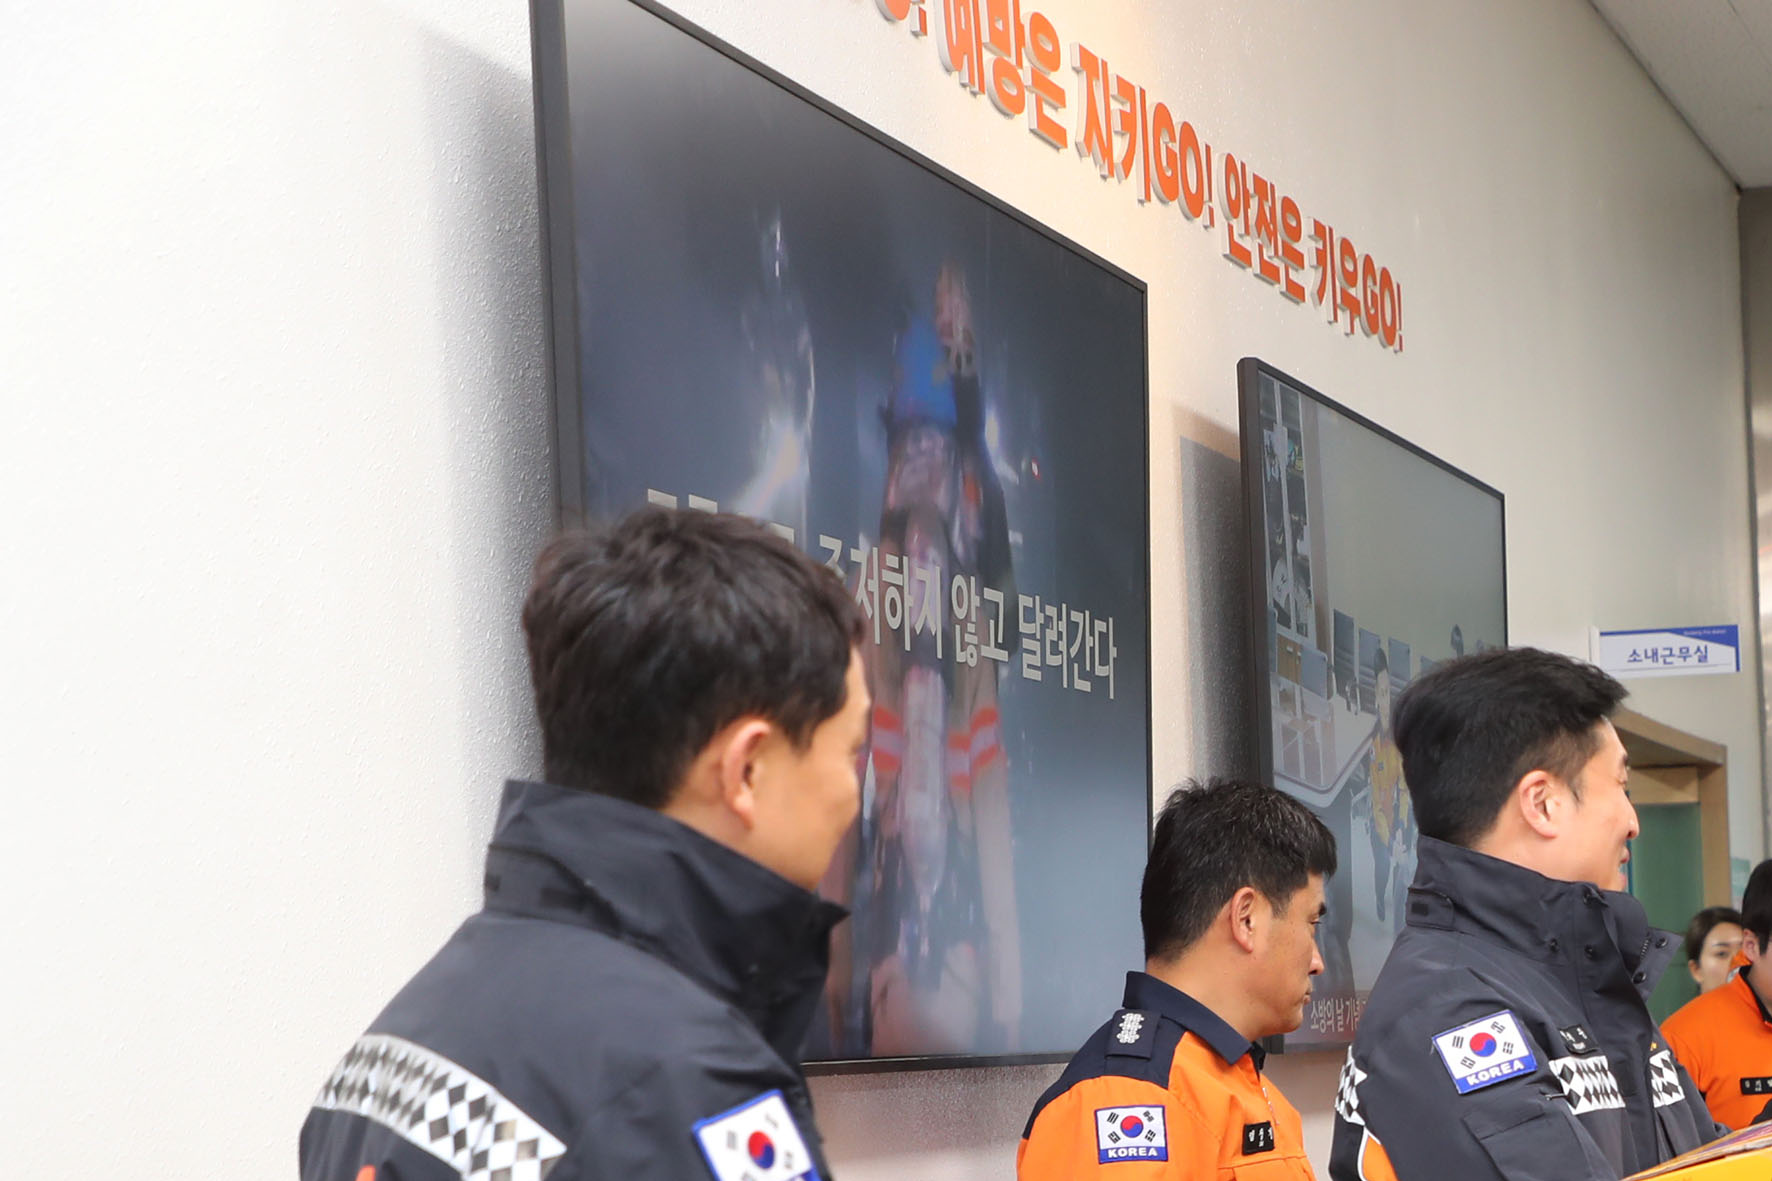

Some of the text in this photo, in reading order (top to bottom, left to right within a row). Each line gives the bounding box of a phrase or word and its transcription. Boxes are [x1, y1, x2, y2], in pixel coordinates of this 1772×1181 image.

[1071, 43, 1215, 228] 지키GO!
[1219, 152, 1306, 305] 안전은
[1307, 216, 1403, 353] 키우GO!
[951, 573, 1010, 668] 않고
[1017, 593, 1117, 700] 달려간다
[1626, 644, 1709, 666] 소내근무실
[1466, 1058, 1525, 1086] KOREA
[1107, 1146, 1158, 1159] KOREA
